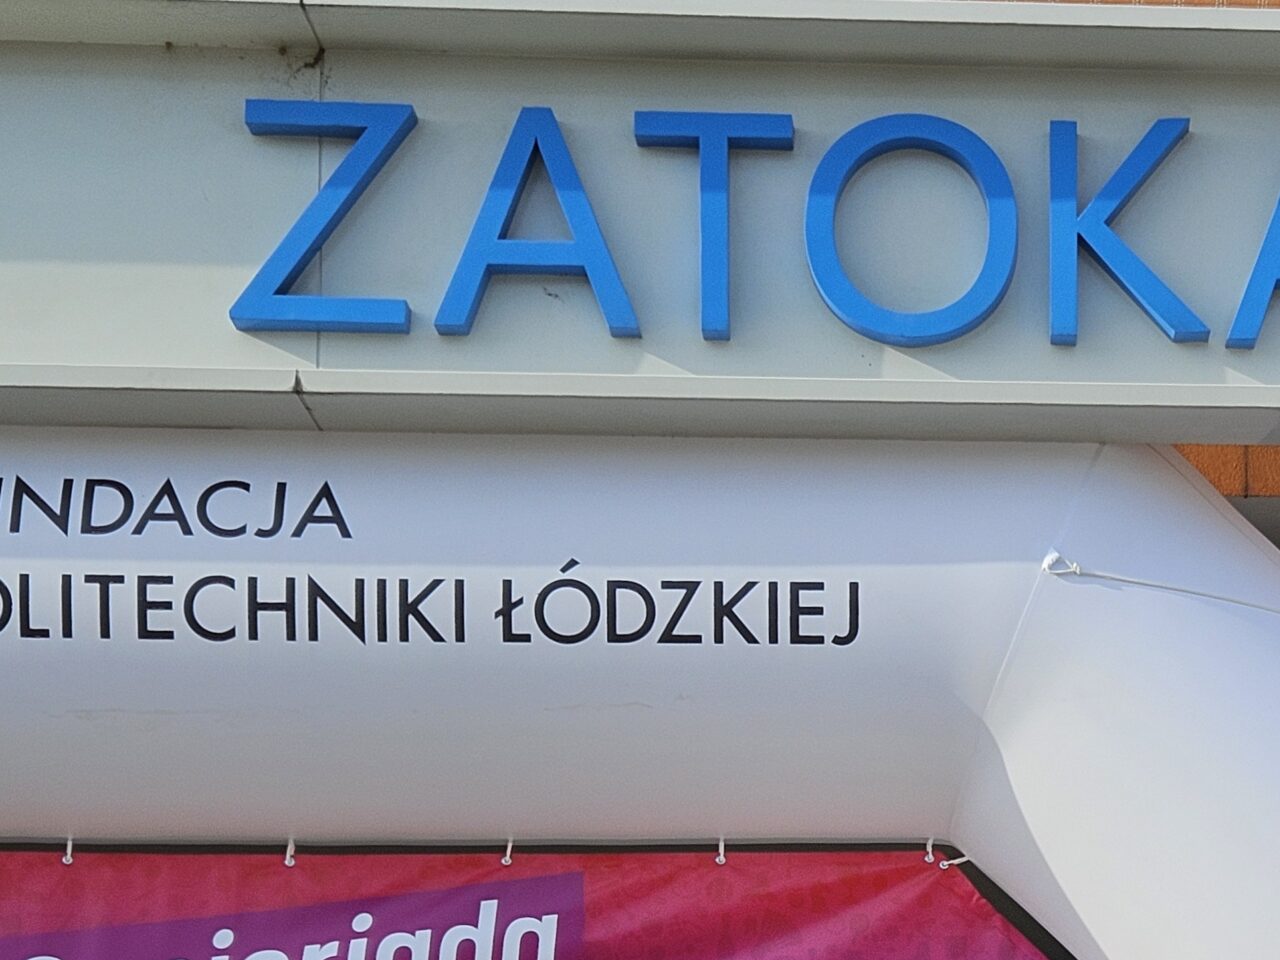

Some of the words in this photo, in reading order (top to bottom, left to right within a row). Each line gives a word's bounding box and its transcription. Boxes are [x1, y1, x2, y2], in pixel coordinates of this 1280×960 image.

[0, 474, 352, 540] NDACJA
[0, 572, 466, 646] LITECHNIKI
[494, 559, 861, 646] ŁÓDZKIEJ
